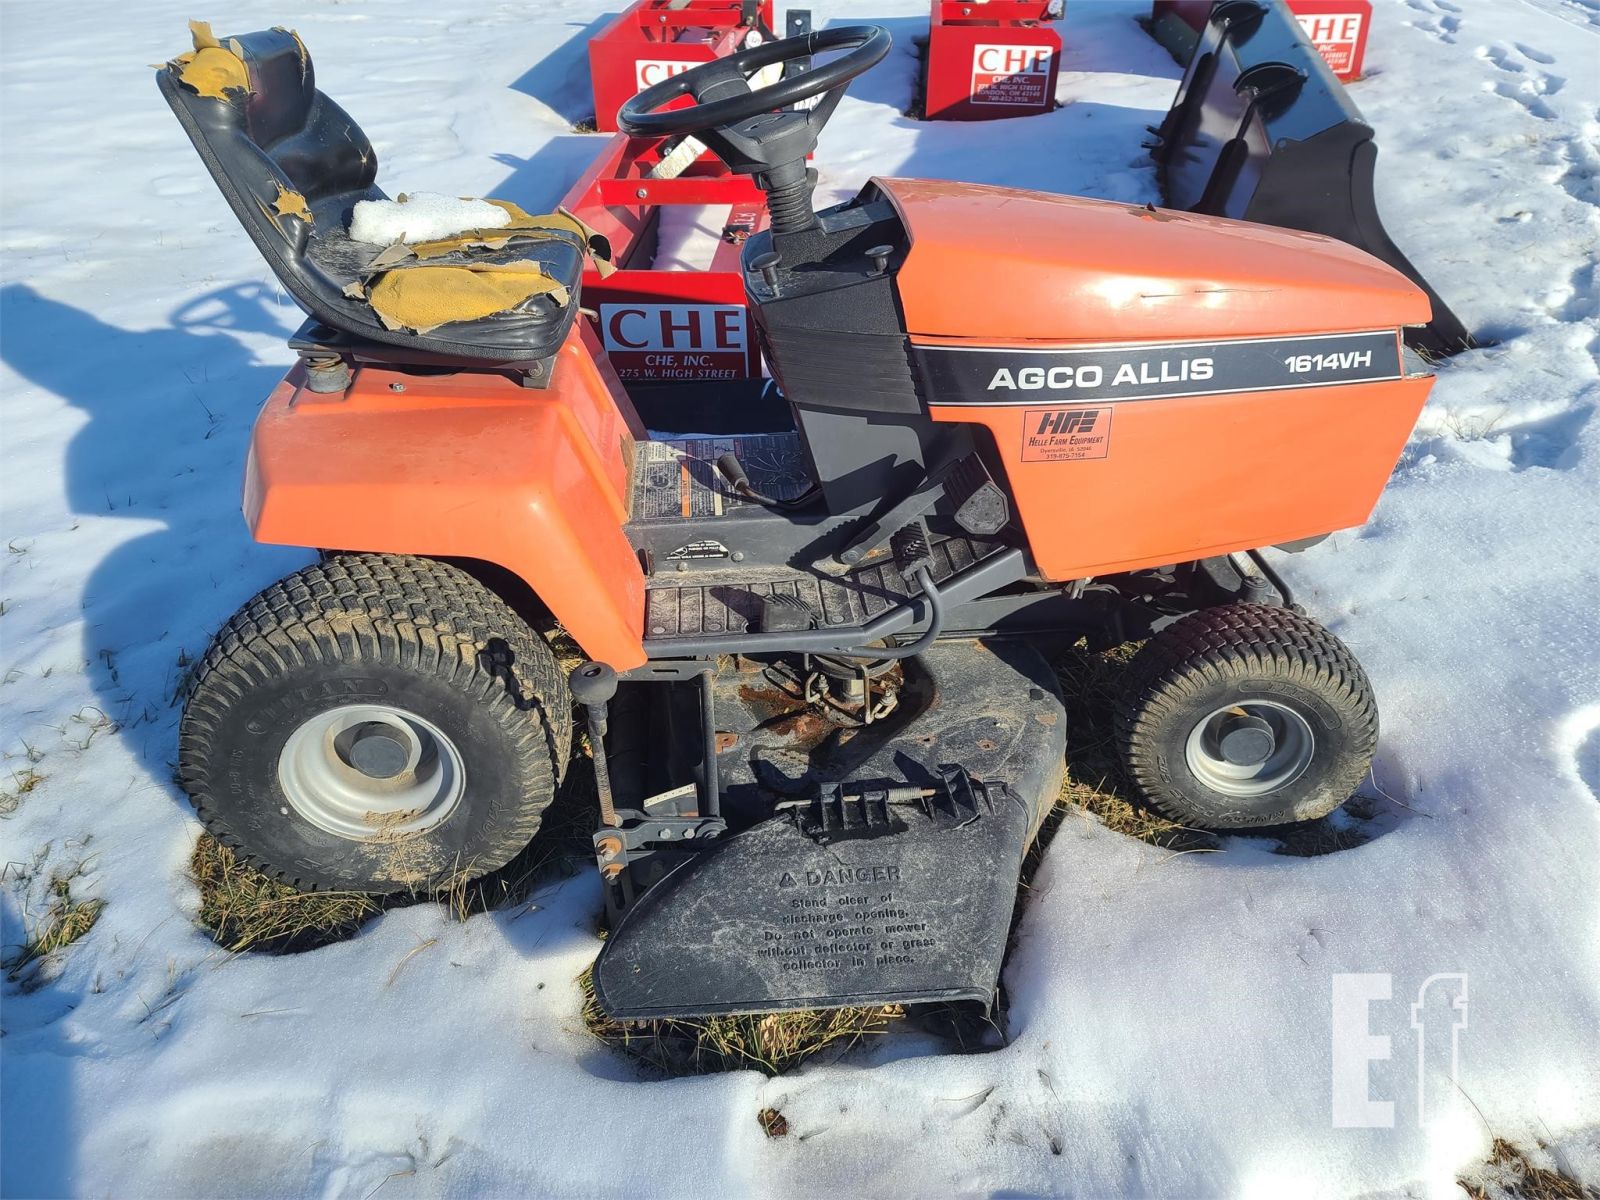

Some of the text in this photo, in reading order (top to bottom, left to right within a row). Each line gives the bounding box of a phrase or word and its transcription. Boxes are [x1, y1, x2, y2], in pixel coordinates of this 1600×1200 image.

[978, 48, 1048, 73] CHE
[609, 309, 741, 349] CHE
[645, 355, 714, 368] CHE, INC.
[987, 350, 1372, 391] AGCO ALLIS 1614VH
[619, 368, 737, 379] 275 W. HIGH STREET
[806, 866, 901, 887] DANGER
[791, 893, 893, 909] Stand clear of
[782, 908, 909, 925] discharge opening.
[764, 922, 927, 941] Do not operate mower
[757, 937, 936, 958] without deflector or grass
[783, 955, 914, 971] collector in place.
